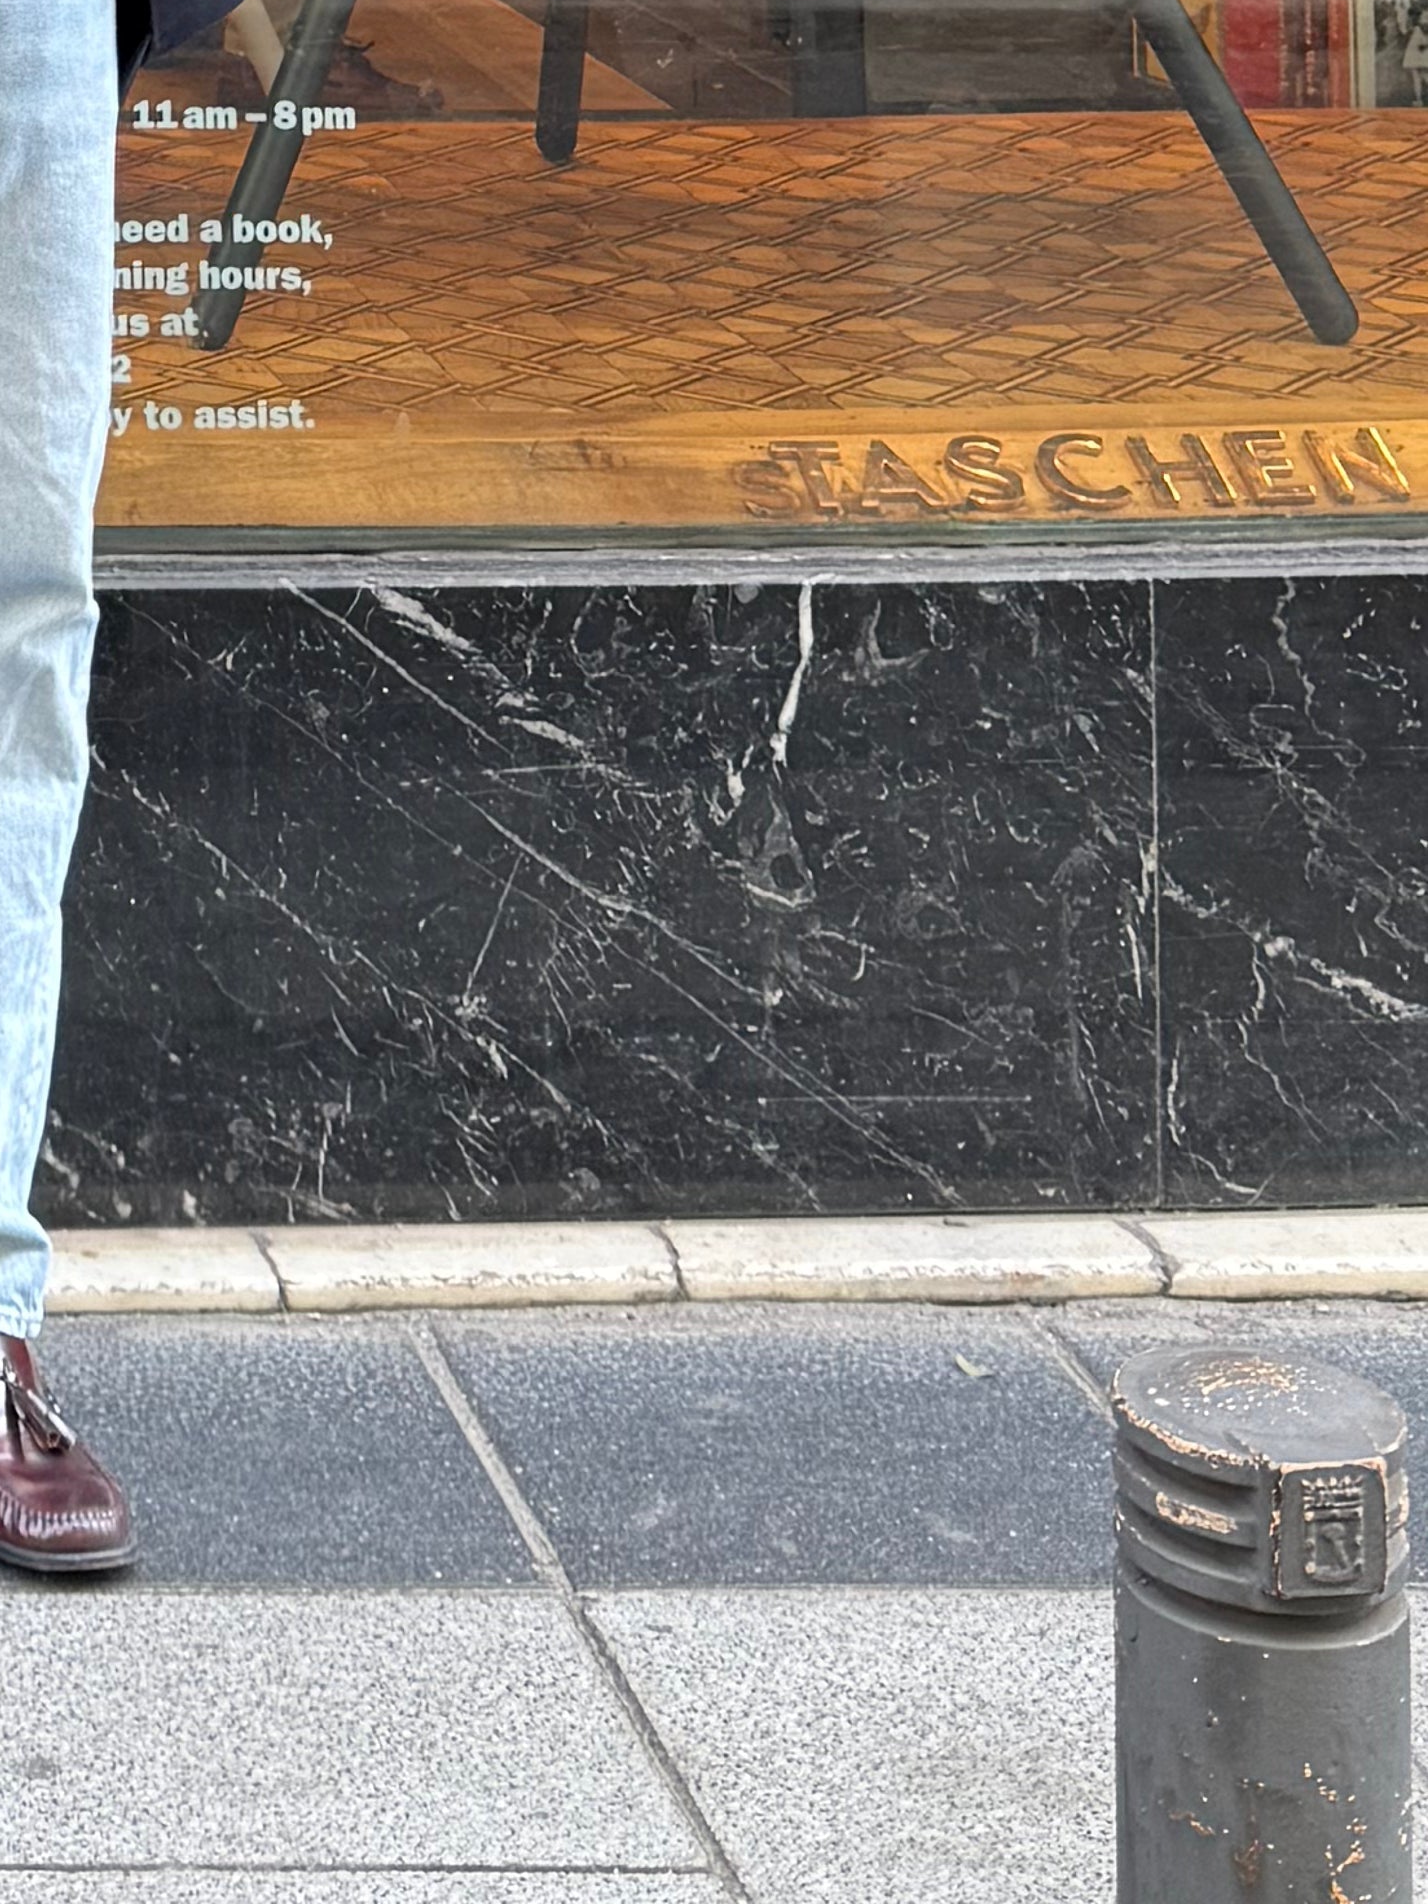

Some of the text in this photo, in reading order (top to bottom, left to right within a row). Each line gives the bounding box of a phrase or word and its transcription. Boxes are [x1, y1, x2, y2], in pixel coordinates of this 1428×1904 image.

[199, 219, 223, 243] a
[232, 214, 333, 250] book,
[199, 260, 313, 296] hours,
[160, 307, 200, 337] at
[143, 400, 183, 431] to
[194, 399, 315, 430] assist.
[767, 427, 1411, 512] TASCHEN
